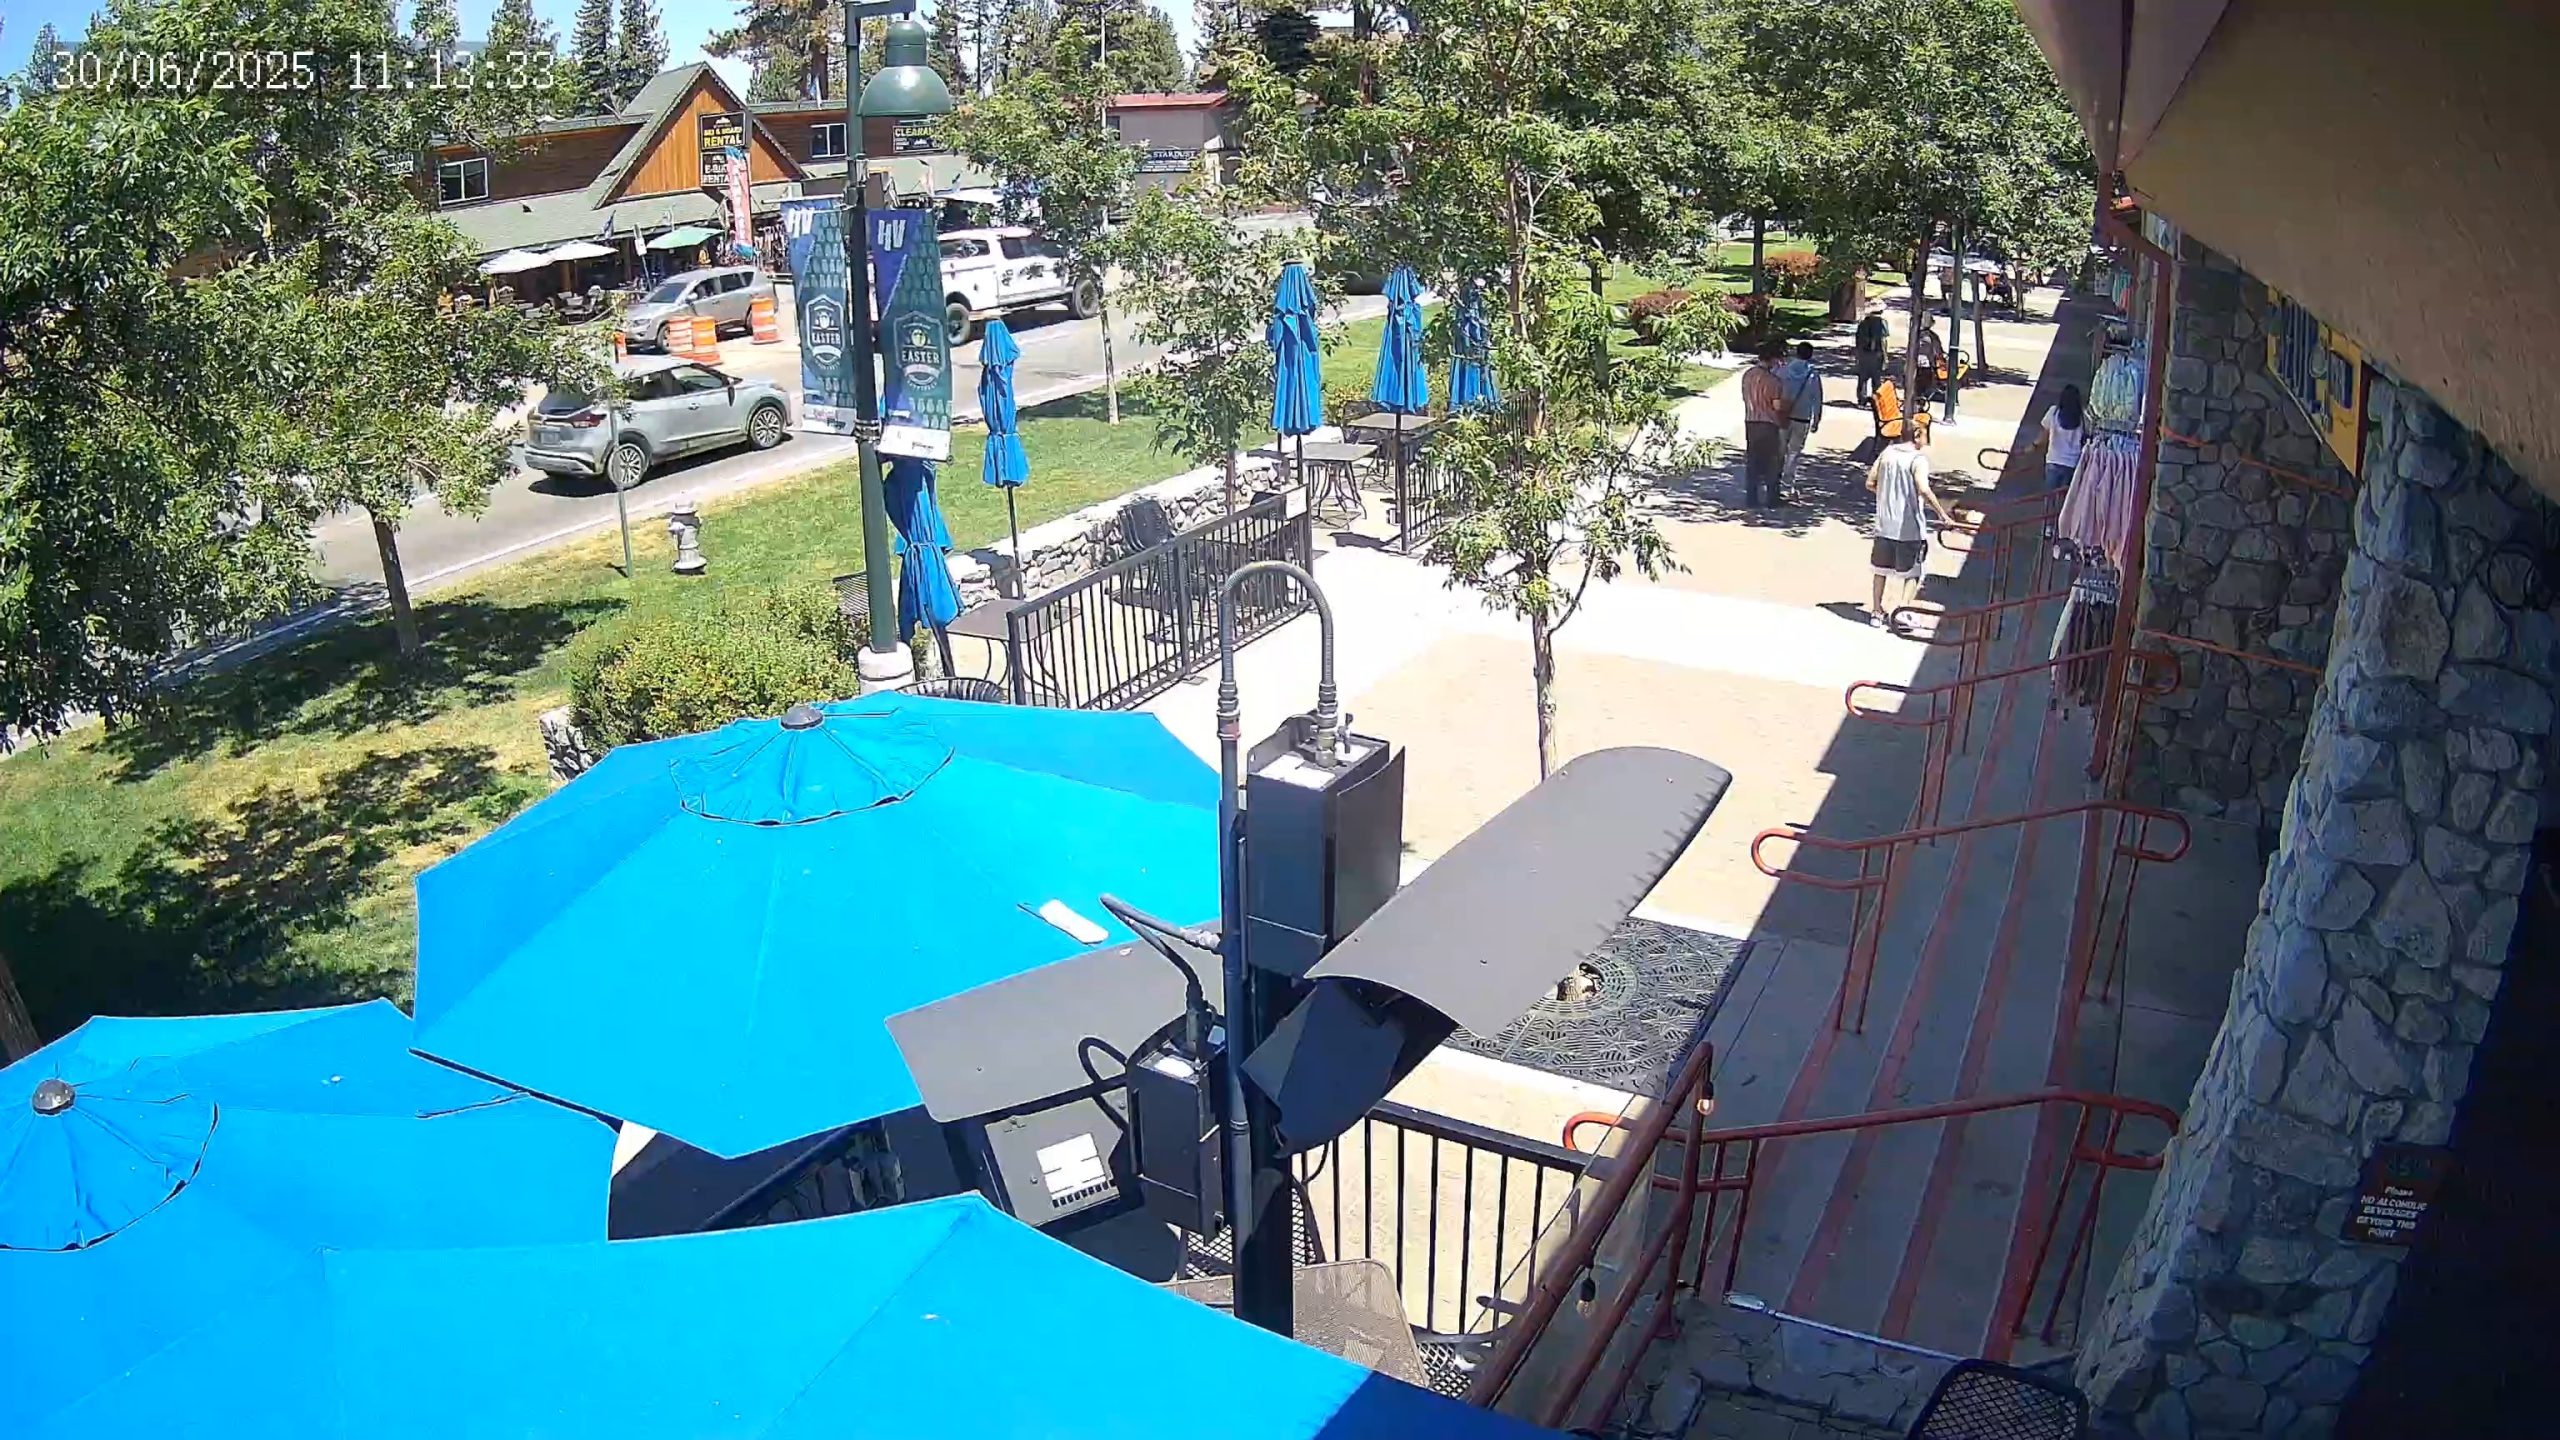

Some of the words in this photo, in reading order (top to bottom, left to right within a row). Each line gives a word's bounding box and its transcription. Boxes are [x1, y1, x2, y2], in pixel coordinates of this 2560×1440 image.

[704, 134, 743, 148] RENTAL
[703, 174, 731, 184] RENTA
[788, 207, 814, 239] HV
[877, 219, 907, 252] HV
[811, 332, 841, 346] EASTER
[902, 351, 940, 363] EASTER
[2361, 1195, 2376, 1205] NO
[2377, 1197, 2427, 1211] ALCOHOLIC
[2363, 1206, 2418, 1218] BEVERAGES
[2356, 1216, 2394, 1227] BEYOND
[2396, 1219, 2417, 1230] THIS
[2368, 1228, 2396, 1238] POINT
